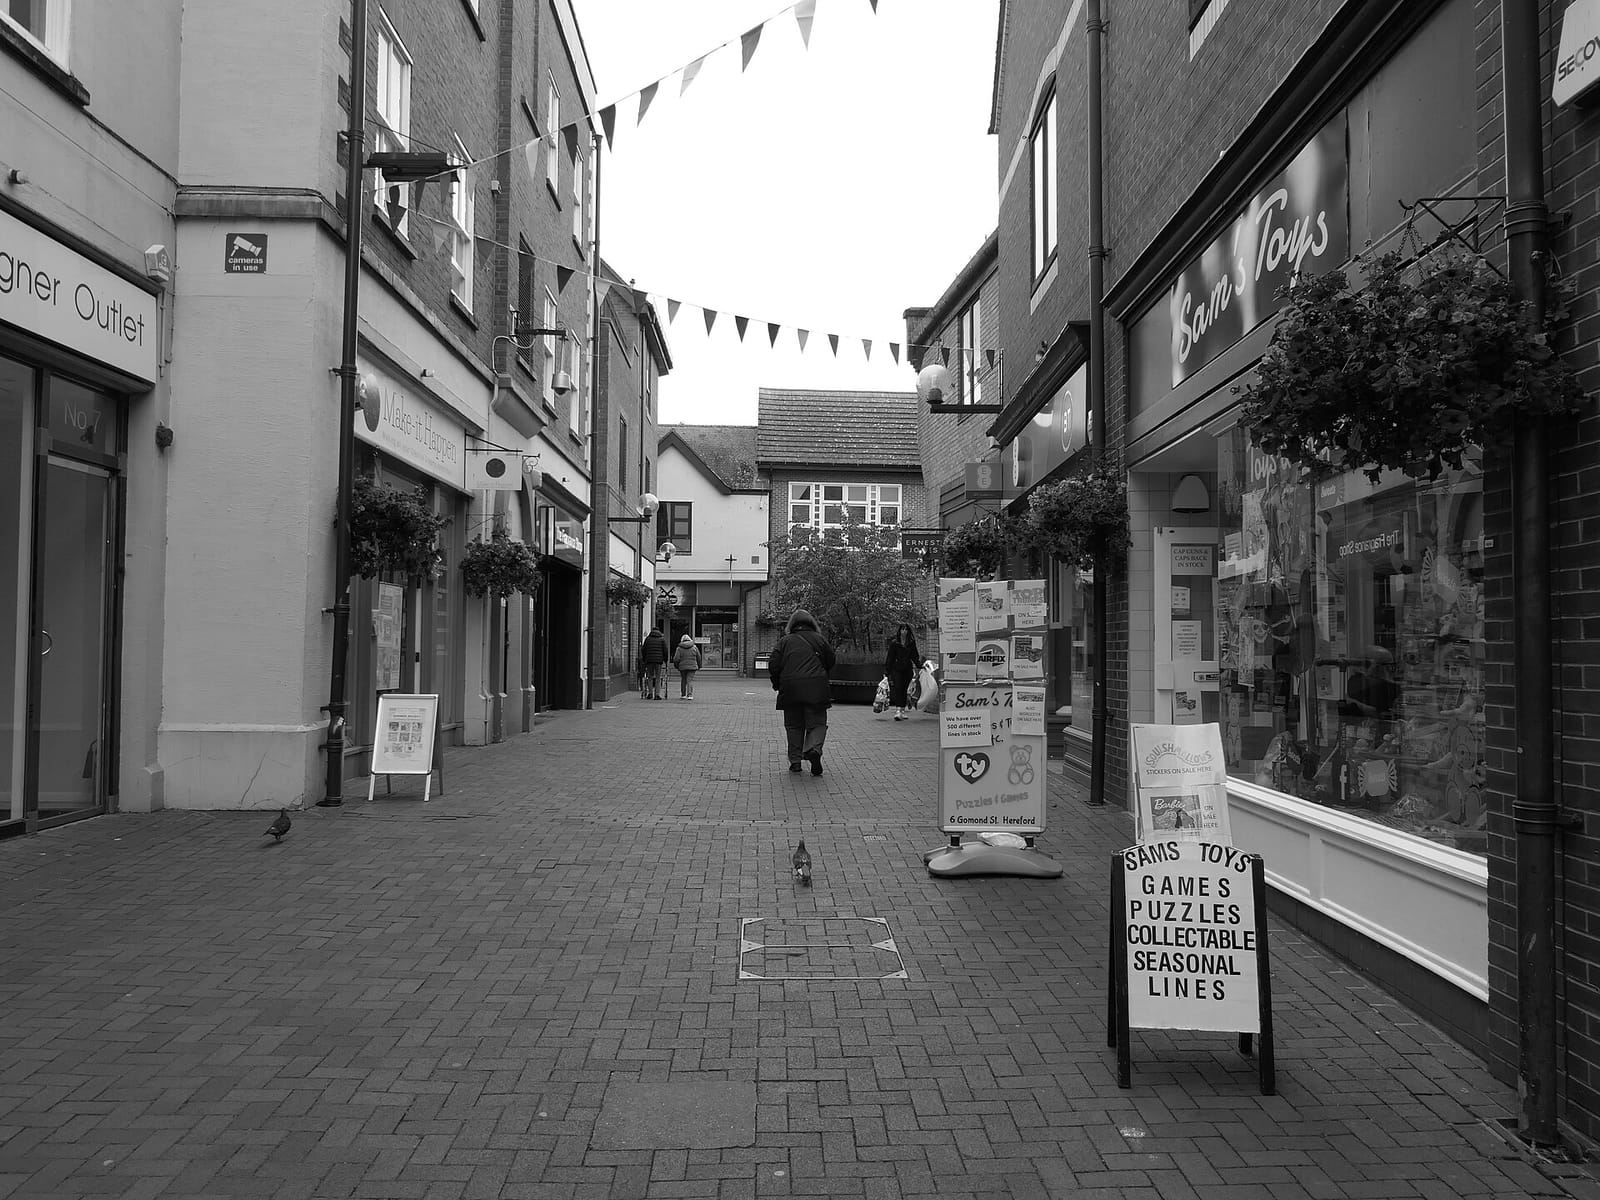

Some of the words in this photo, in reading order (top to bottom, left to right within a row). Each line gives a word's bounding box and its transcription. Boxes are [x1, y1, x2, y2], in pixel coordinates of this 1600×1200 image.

[1558, 36, 1600, 82] SECO
[232, 263, 241, 271] in
[1178, 224, 1246, 364] Sam's
[1254, 188, 1329, 288] Toys
[74, 283, 145, 347] Outlet
[93, 409, 102, 433] 7
[383, 387, 423, 443] Make-it
[423, 411, 457, 464] Happen
[977, 655, 1006, 663] AIRFIX
[955, 690, 999, 709] Sam's
[956, 753, 986, 778] ty
[956, 796, 993, 810] Puzzles
[1154, 798, 1185, 810] Barbie
[949, 815, 956, 824] 6
[957, 815, 988, 824] Gomond
[1002, 815, 1036, 825] Hereford
[1125, 841, 1181, 871] SAMS
[1198, 842, 1252, 873] TOYS
[1142, 875, 1231, 898] GAMES
[1130, 900, 1241, 925] PUZZLES
[1127, 924, 1256, 951] COLLECTABLE
[1133, 950, 1241, 976] SEASONAL
[1149, 976, 1225, 1001] LINES
